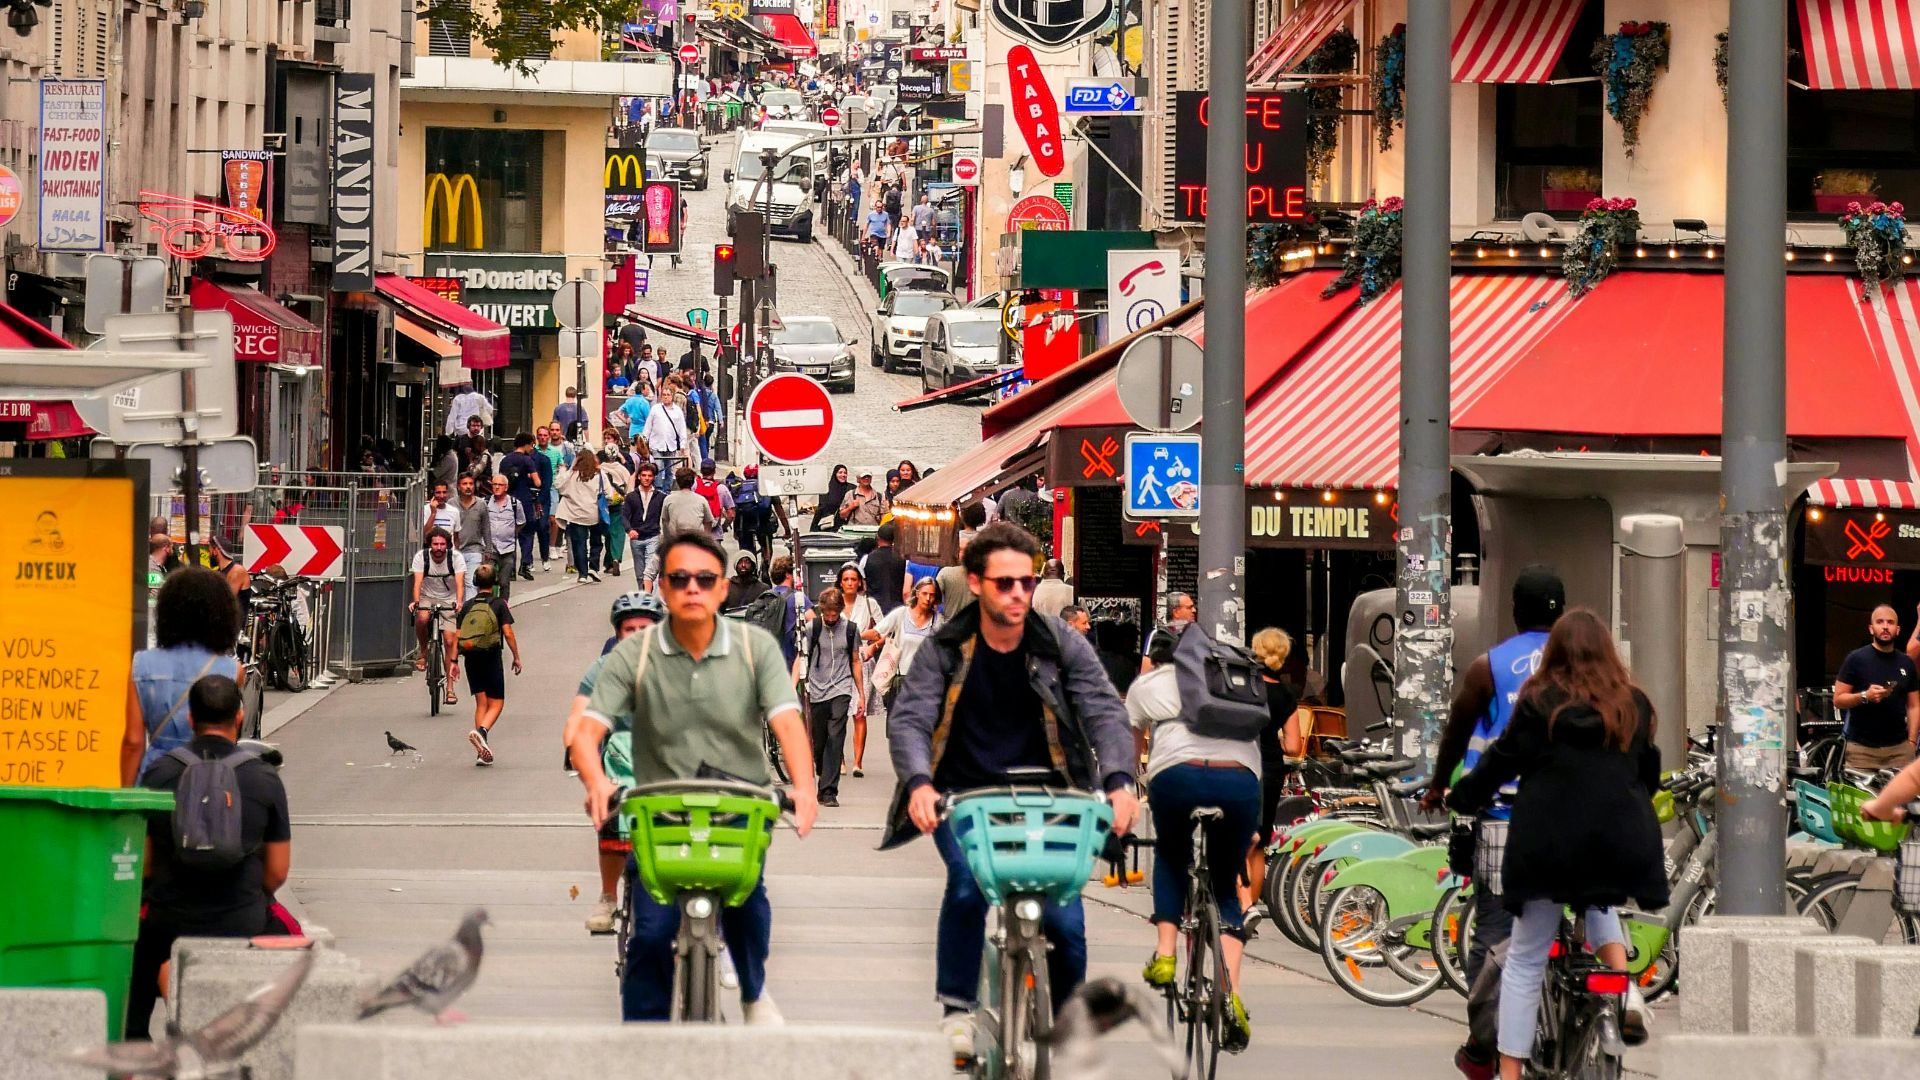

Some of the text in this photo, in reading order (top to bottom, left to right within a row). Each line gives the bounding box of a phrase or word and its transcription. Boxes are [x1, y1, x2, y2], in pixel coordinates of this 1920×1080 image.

[922, 51, 936, 59] OK
[45, 85, 101, 96] RESTAURAT
[1074, 90, 1102, 102] FDJ
[48, 112, 99, 121] CHICKEN
[1017, 64, 1054, 157] TABAC
[43, 127, 101, 142] FAST-FOOD
[44, 150, 100, 172] INDIEN
[222, 151, 273, 160] SANDWICH
[42, 179, 101, 198] PAKISTANAIS
[239, 163, 249, 208] KEBAB
[335, 87, 372, 277] MANDIN
[52, 209, 91, 222] HALAL
[12, 402, 31, 417] D'OR
[780, 468, 807, 477] SAUF
[1251, 505, 1369, 538] DU TEMPLE
[16, 561, 77, 581] JOYEUX
[2, 638, 56, 659] VOUS
[2, 667, 100, 690] PRENDREZ
[51, 698, 88, 720] UNE
[2, 729, 101, 752] TASSE DE
